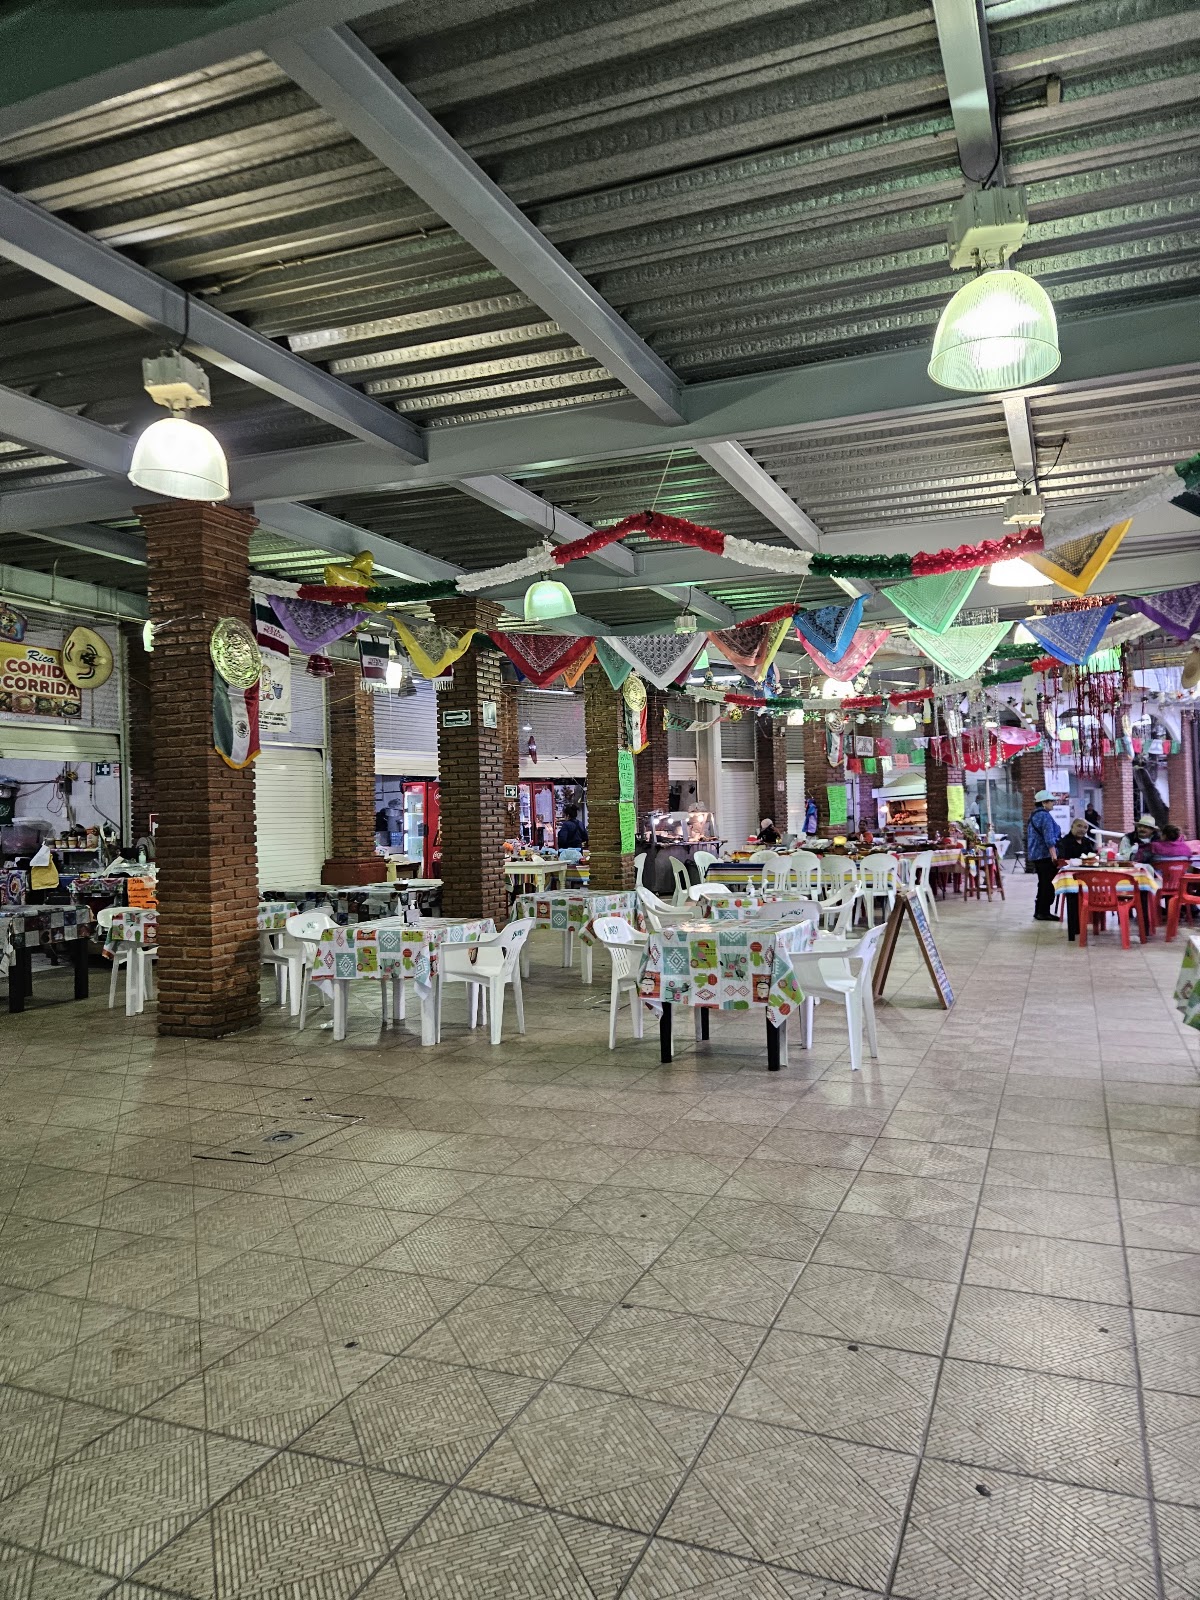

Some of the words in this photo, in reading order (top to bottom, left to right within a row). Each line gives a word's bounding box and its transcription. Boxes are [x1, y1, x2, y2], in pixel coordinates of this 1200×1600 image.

[27, 650, 55, 664] Rica
[6, 659, 67, 680] COMID
[3, 675, 78, 697] CORRIDA
